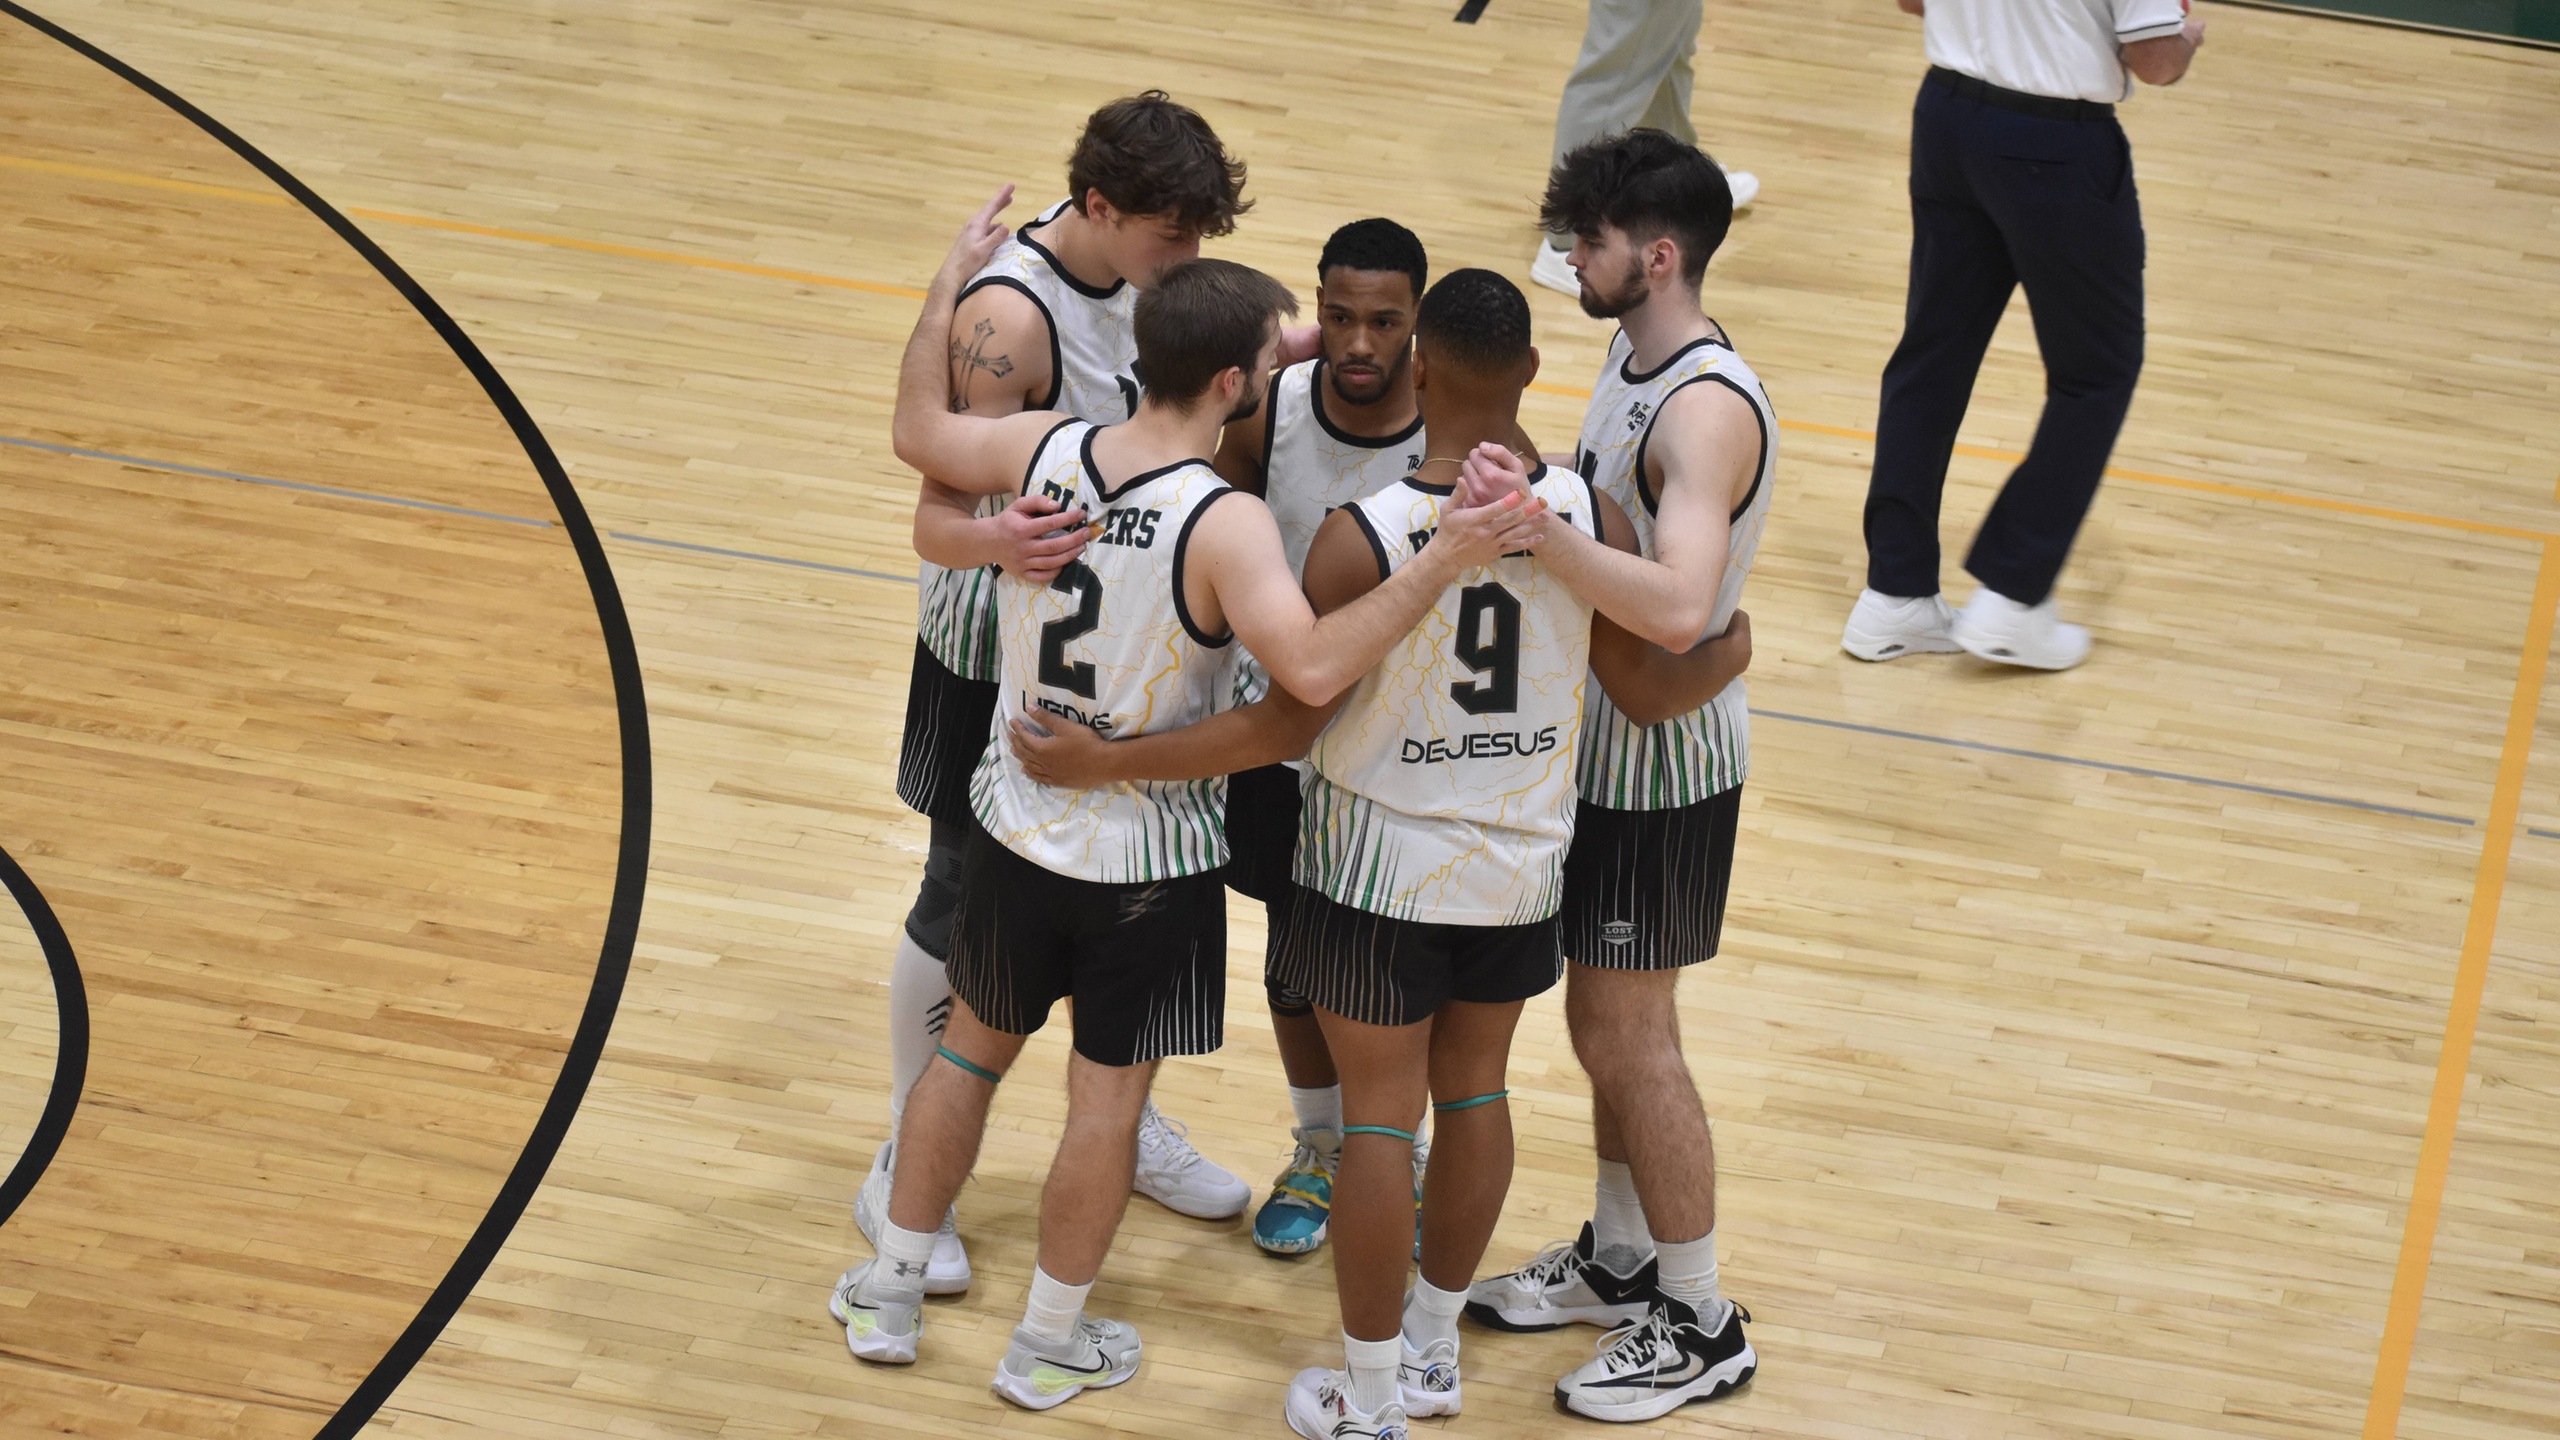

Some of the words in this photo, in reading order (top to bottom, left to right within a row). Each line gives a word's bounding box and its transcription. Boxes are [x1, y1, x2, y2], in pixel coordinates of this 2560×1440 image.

[1038, 558, 1103, 700] 2
[1450, 582, 1521, 715] 9
[1401, 726, 1557, 764] DEJESUS
[1605, 926, 1633, 935] LOST
